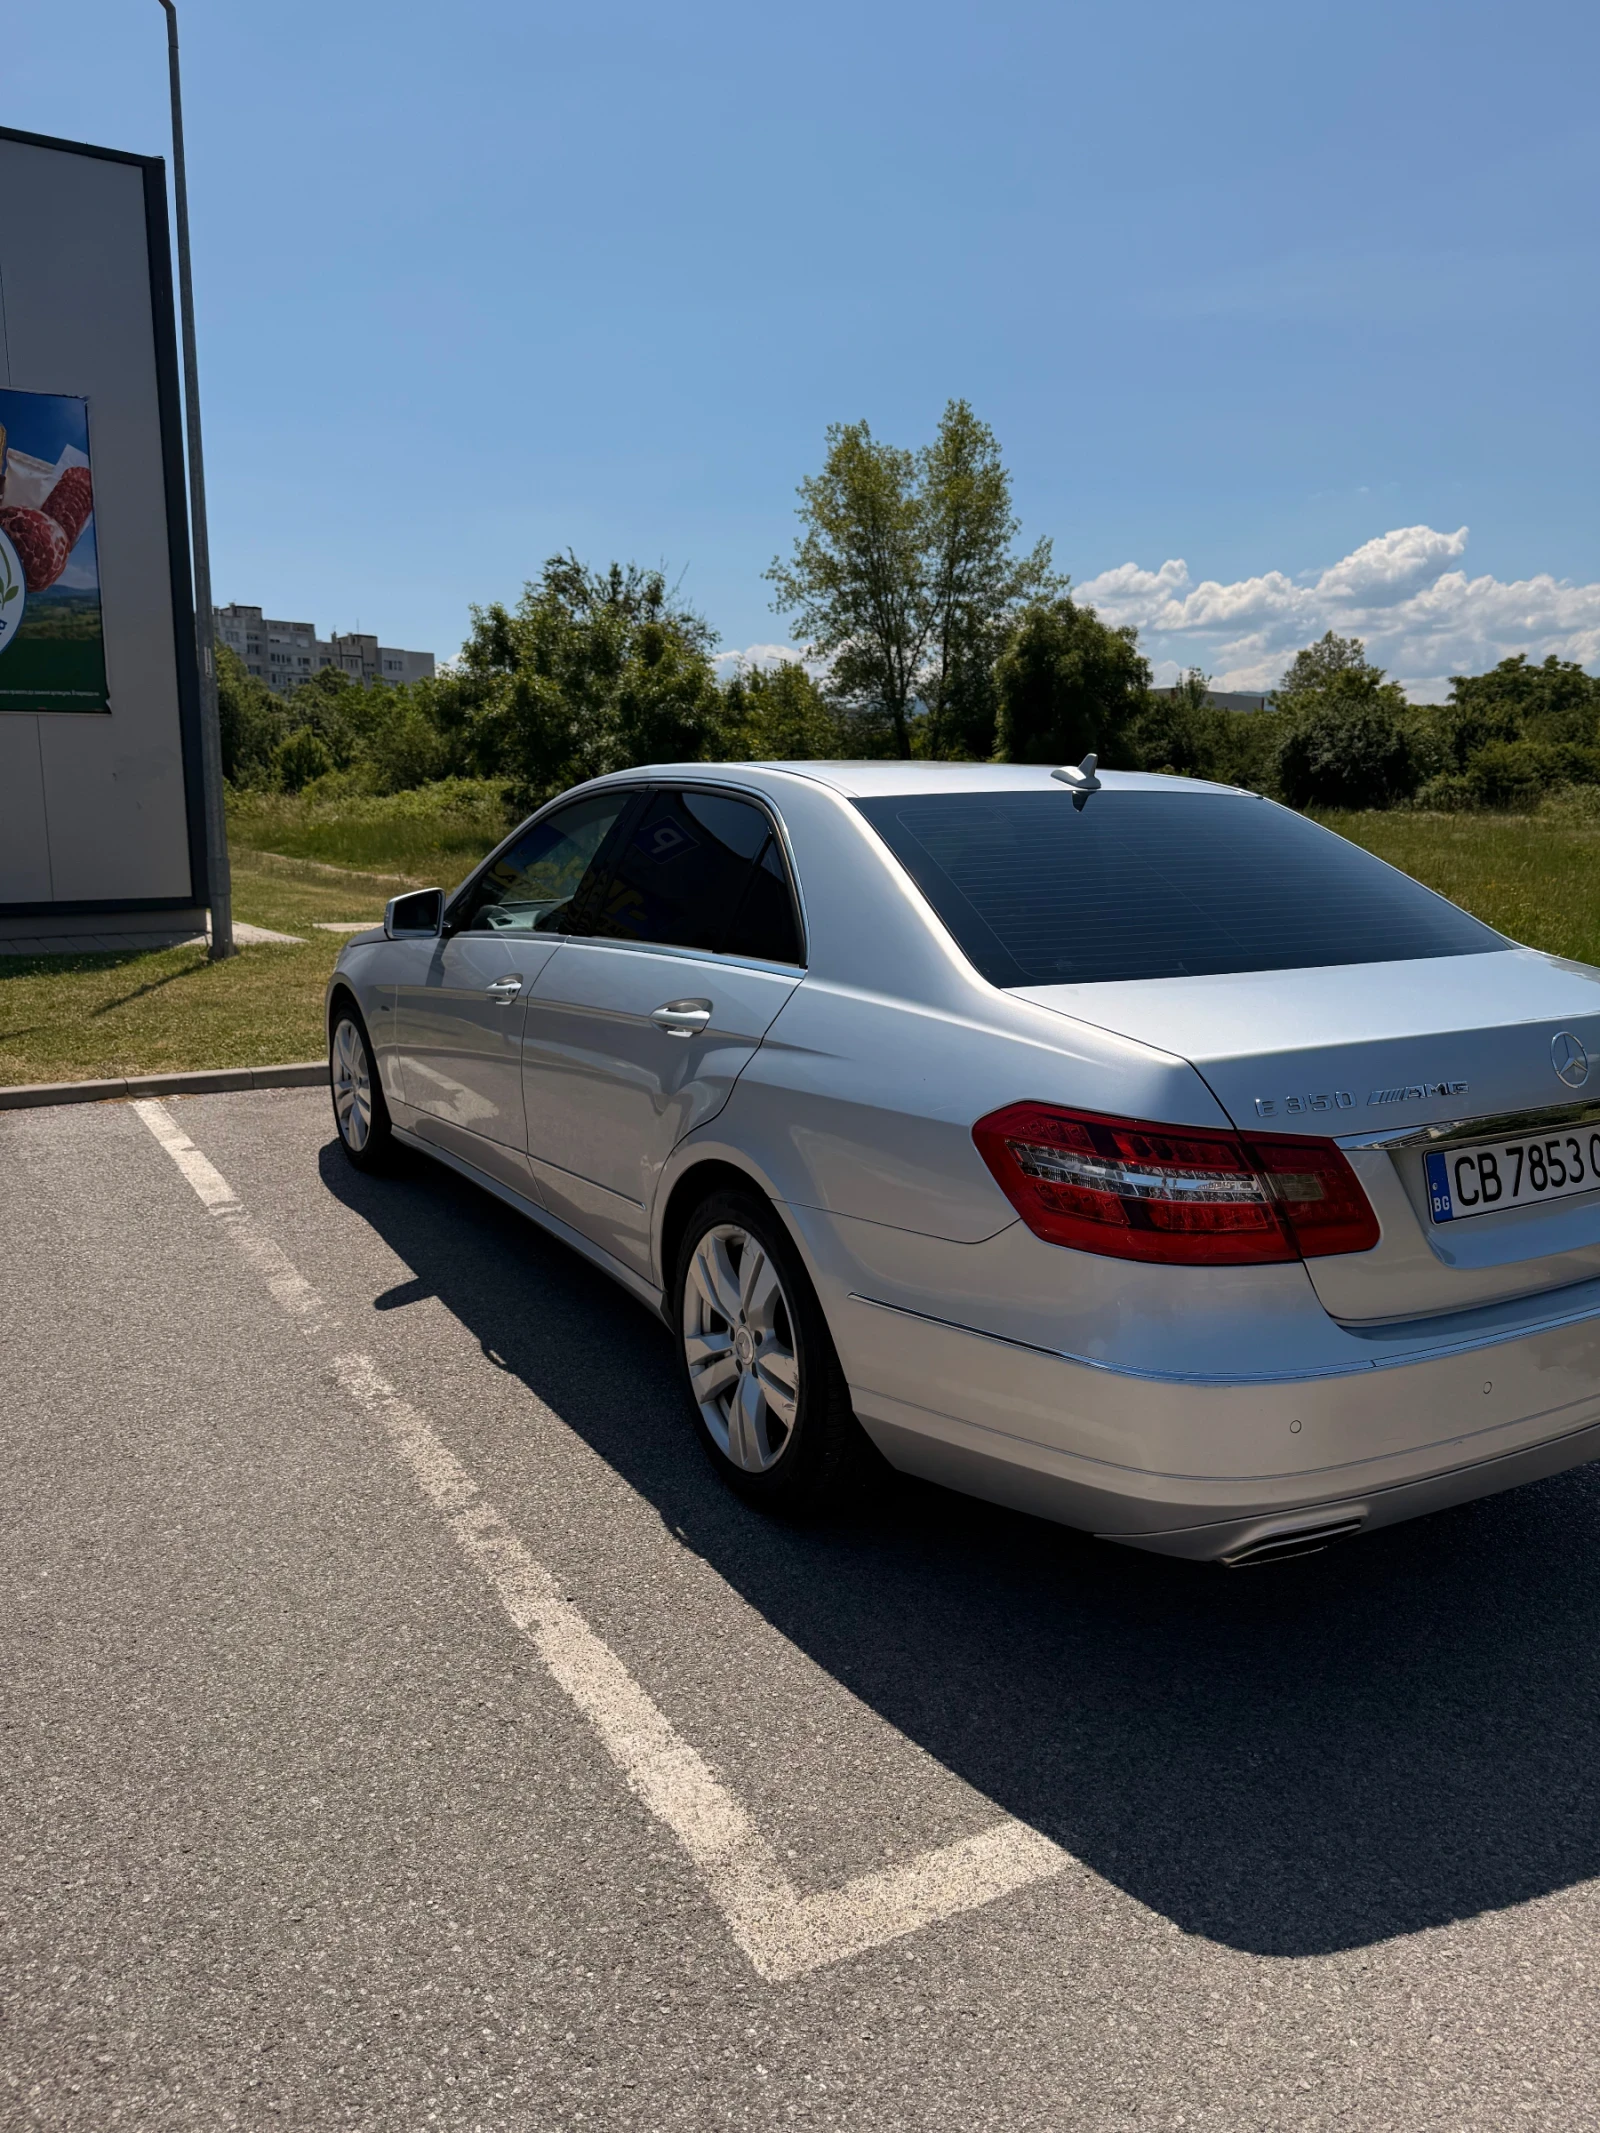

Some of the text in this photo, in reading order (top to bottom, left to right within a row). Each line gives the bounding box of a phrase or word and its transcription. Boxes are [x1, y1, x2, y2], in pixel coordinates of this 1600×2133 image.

[1255, 1080, 1469, 1117] E 350 AMG
[1454, 1152, 1502, 1206] CB
[1505, 1137, 1585, 1197] 7853
[1433, 1197, 1450, 1212] BG
